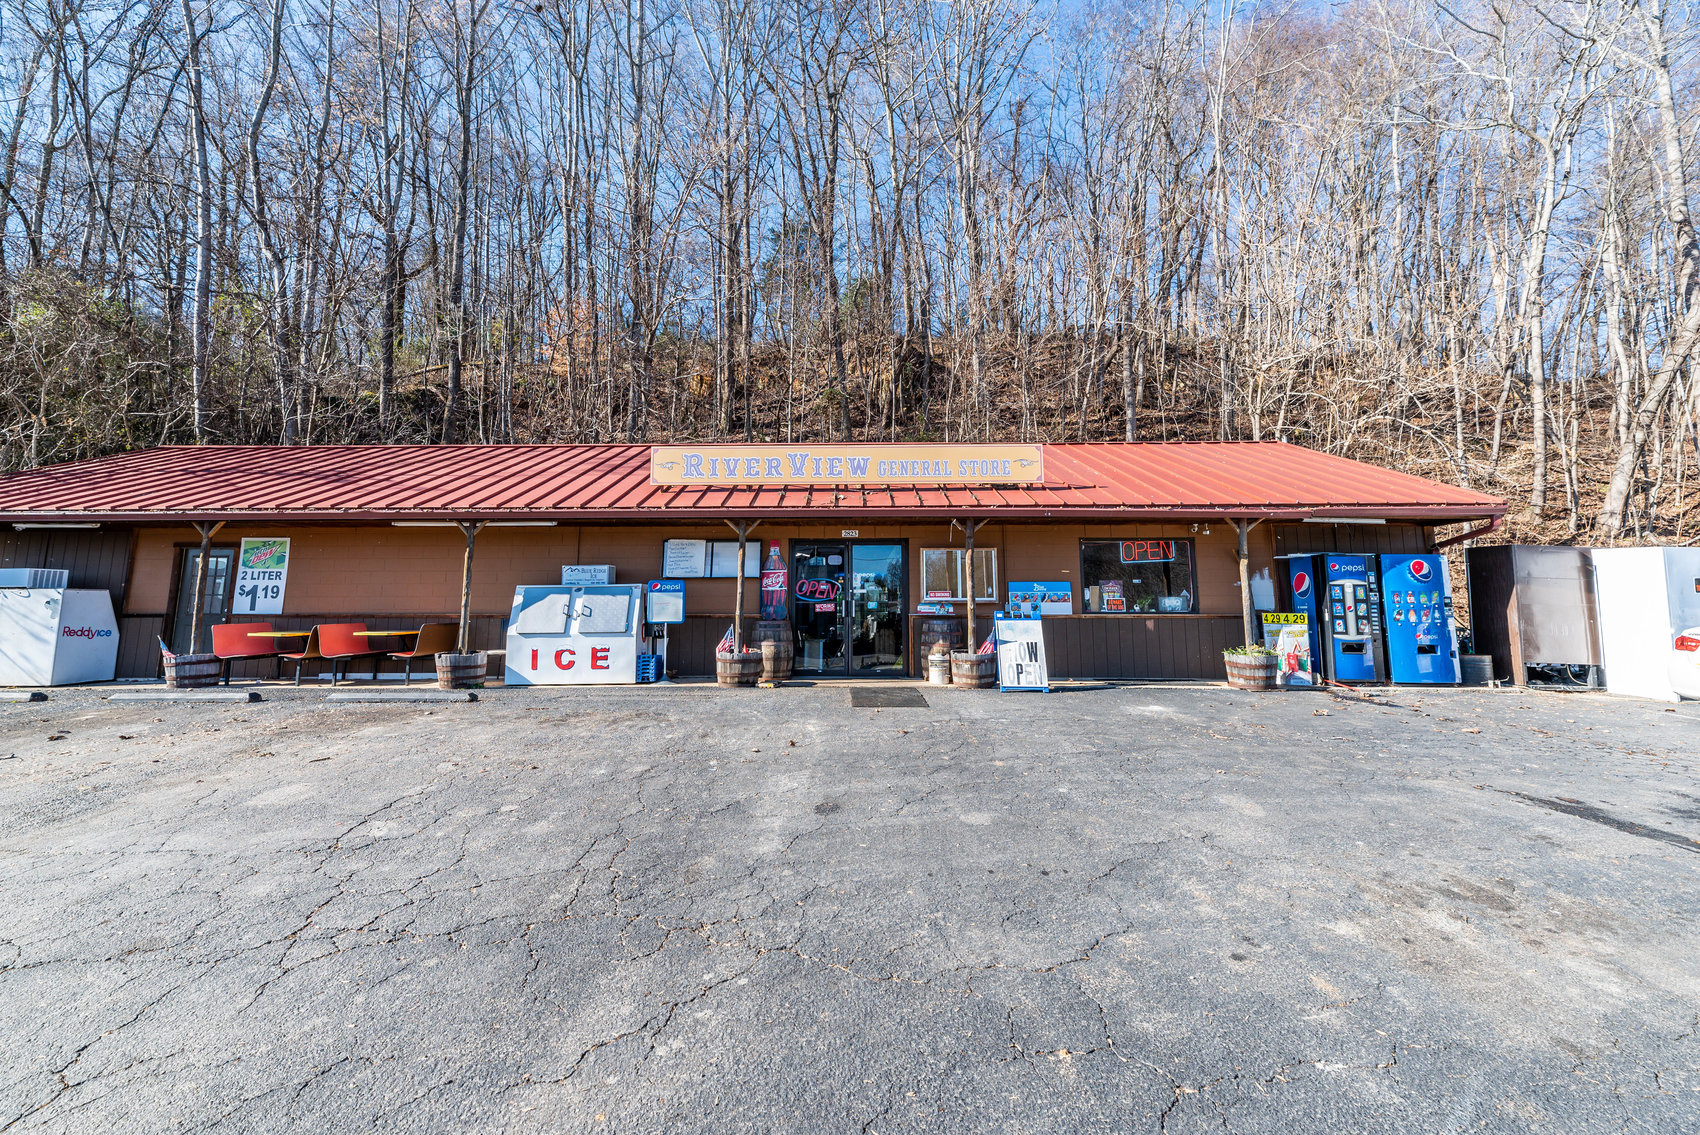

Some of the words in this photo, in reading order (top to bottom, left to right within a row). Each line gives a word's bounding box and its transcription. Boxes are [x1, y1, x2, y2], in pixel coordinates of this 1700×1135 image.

[878, 459, 952, 477] GENERAL
[958, 459, 1011, 477] STORE
[1122, 540, 1173, 561] OPEN
[240, 571, 248, 580] 2
[250, 571, 282, 580] LITER
[1341, 564, 1365, 572] pepsi
[661, 583, 681, 591] pepsi
[763, 572, 784, 587] Coca-Cola
[238, 584, 280, 611] $1.19
[796, 579, 838, 600] OPEN
[531, 646, 610, 671] ICE
